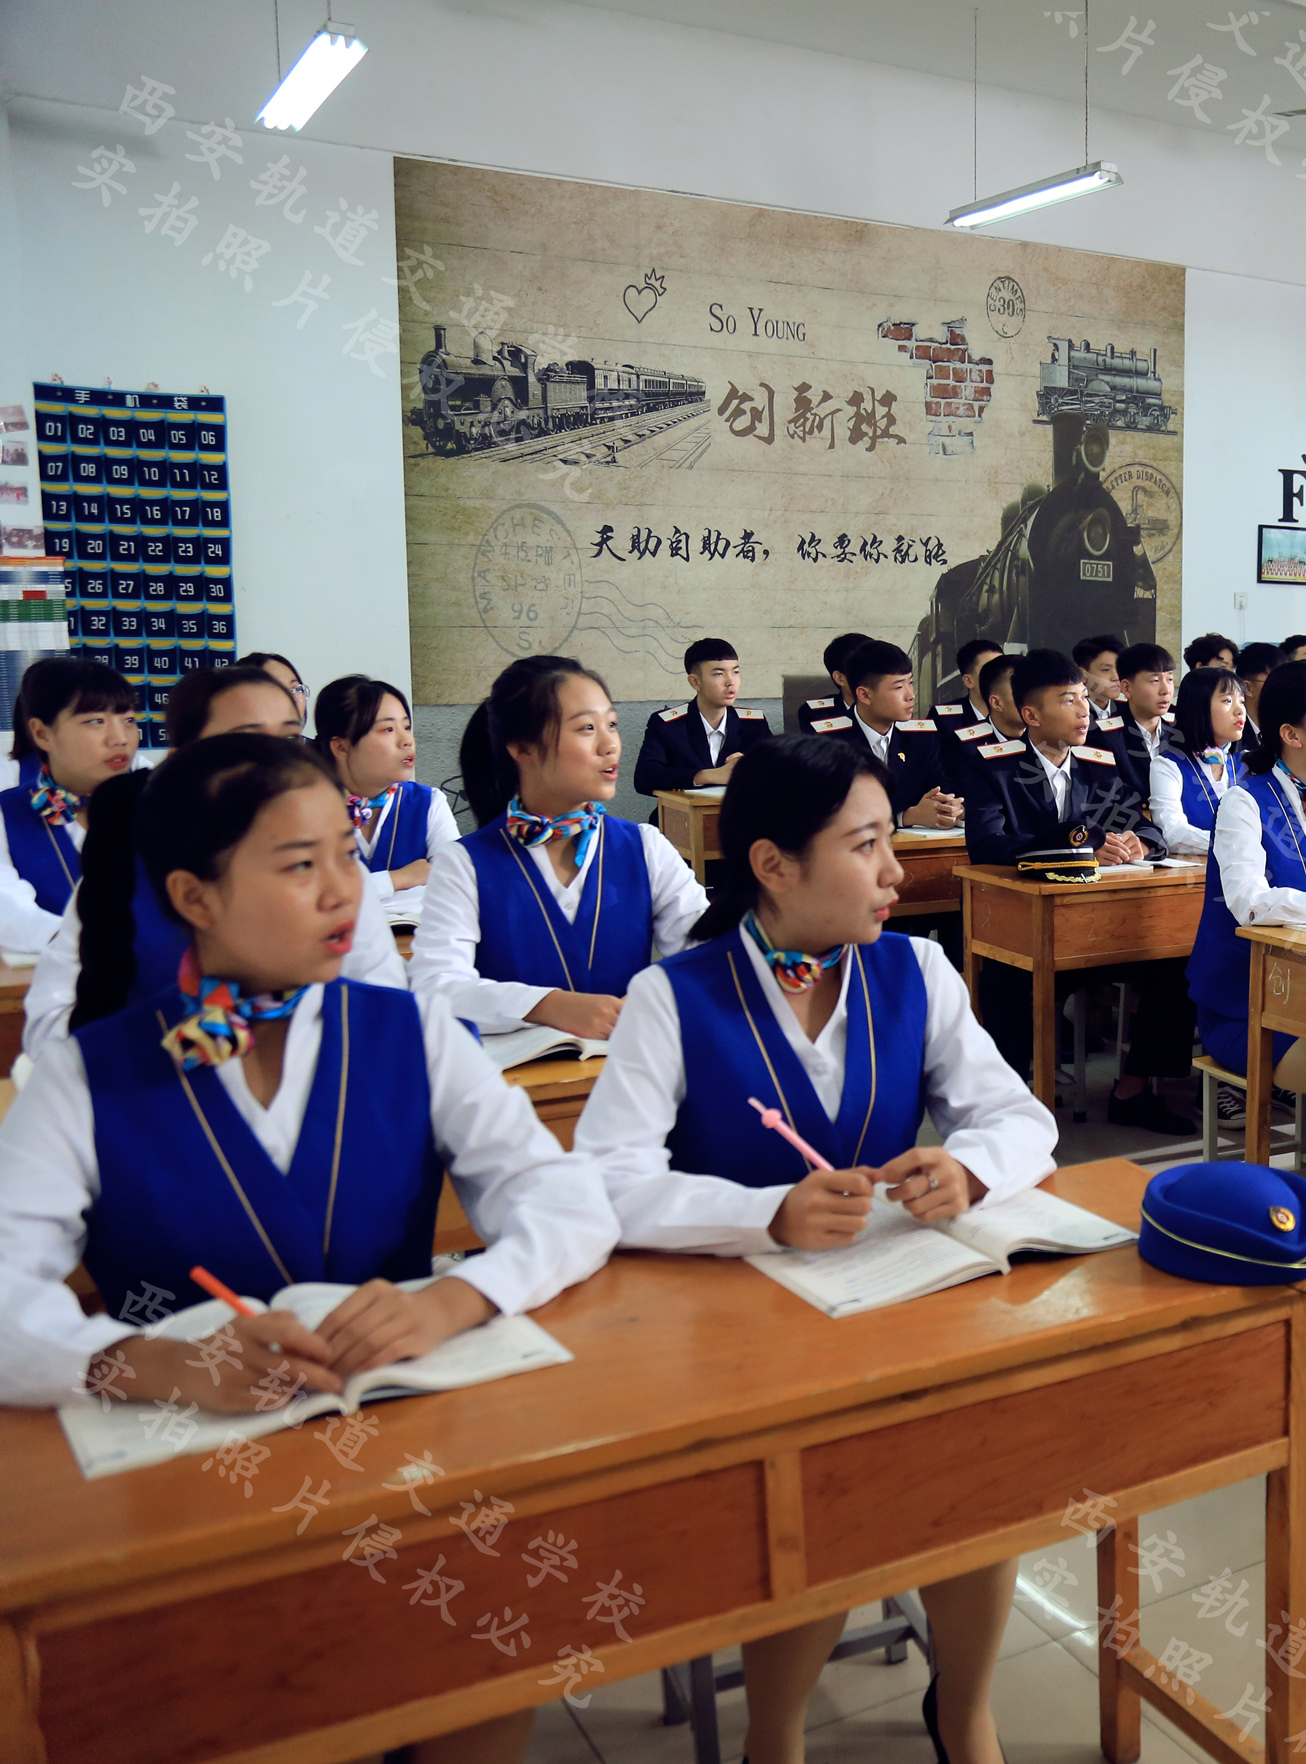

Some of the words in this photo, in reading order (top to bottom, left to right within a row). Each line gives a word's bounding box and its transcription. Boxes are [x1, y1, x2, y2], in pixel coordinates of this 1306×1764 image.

[998, 296, 1015, 318] 30
[46, 422, 62, 436] 01
[78, 424, 94, 439] 02
[110, 427, 125, 441] 03
[140, 429, 155, 442] 04
[171, 430, 186, 444] 05
[201, 431, 216, 445] 06
[48, 462, 63, 475] 07
[80, 463, 96, 477] 08
[113, 465, 128, 479] 09
[143, 467, 159, 480] 10
[174, 469, 189, 482] 11
[203, 471, 219, 484] 12
[51, 501, 67, 514] 13
[83, 502, 98, 515] 14
[115, 504, 131, 518] 15
[145, 506, 161, 519] 16
[175, 507, 190, 520] 17
[206, 508, 222, 521] 18
[55, 538, 69, 552] 19
[87, 540, 103, 553] 20
[119, 541, 135, 554] 21
[148, 542, 163, 555] 22
[178, 543, 193, 556] 23
[207, 543, 222, 557] 24
[1085, 565, 1108, 578] 0751
[88, 580, 103, 593] 26
[119, 580, 134, 593] 27
[149, 582, 164, 595] 28
[179, 583, 195, 596] 29
[209, 584, 224, 597] 30
[91, 616, 106, 629] 32
[122, 617, 137, 630] 33
[151, 618, 166, 630] 34
[182, 620, 197, 632] 35
[212, 621, 227, 633] 36
[124, 656, 139, 668] 39
[154, 657, 169, 669] 40
